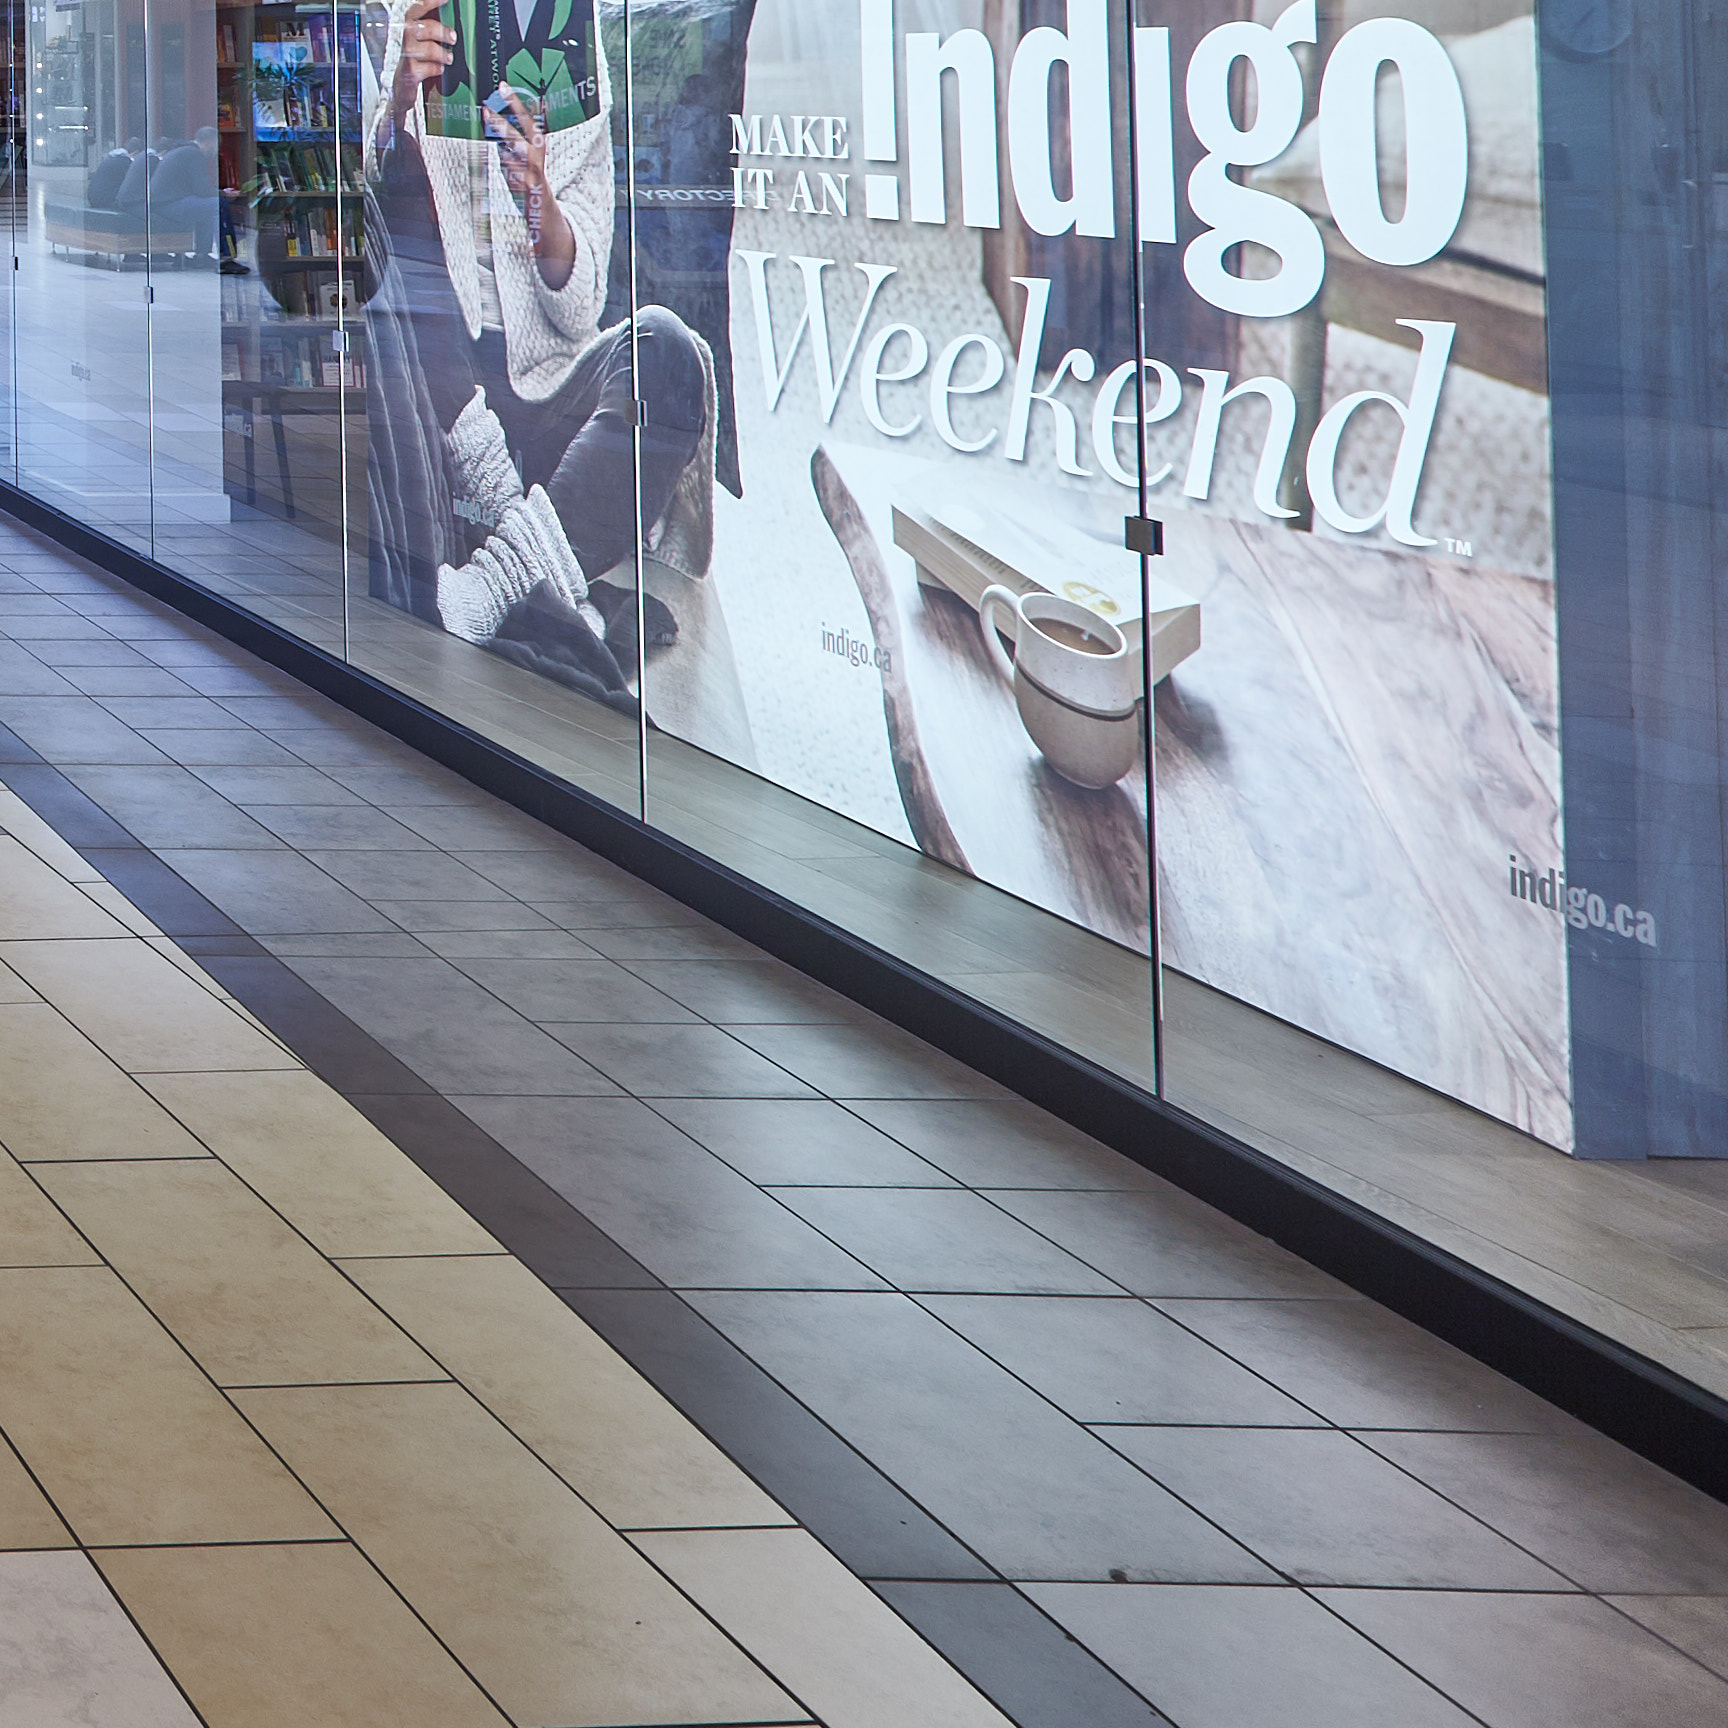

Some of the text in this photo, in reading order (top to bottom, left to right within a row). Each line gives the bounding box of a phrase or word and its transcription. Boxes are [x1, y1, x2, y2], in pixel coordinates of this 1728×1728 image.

[424, 101, 483, 121] TESTAMENT
[727, 112, 850, 160] MAKE
[729, 166, 850, 217] IT AN
[734, 247, 1457, 548] Weekend
[820, 621, 893, 674] indigo.ca
[1508, 854, 1658, 948] indigo.ca
